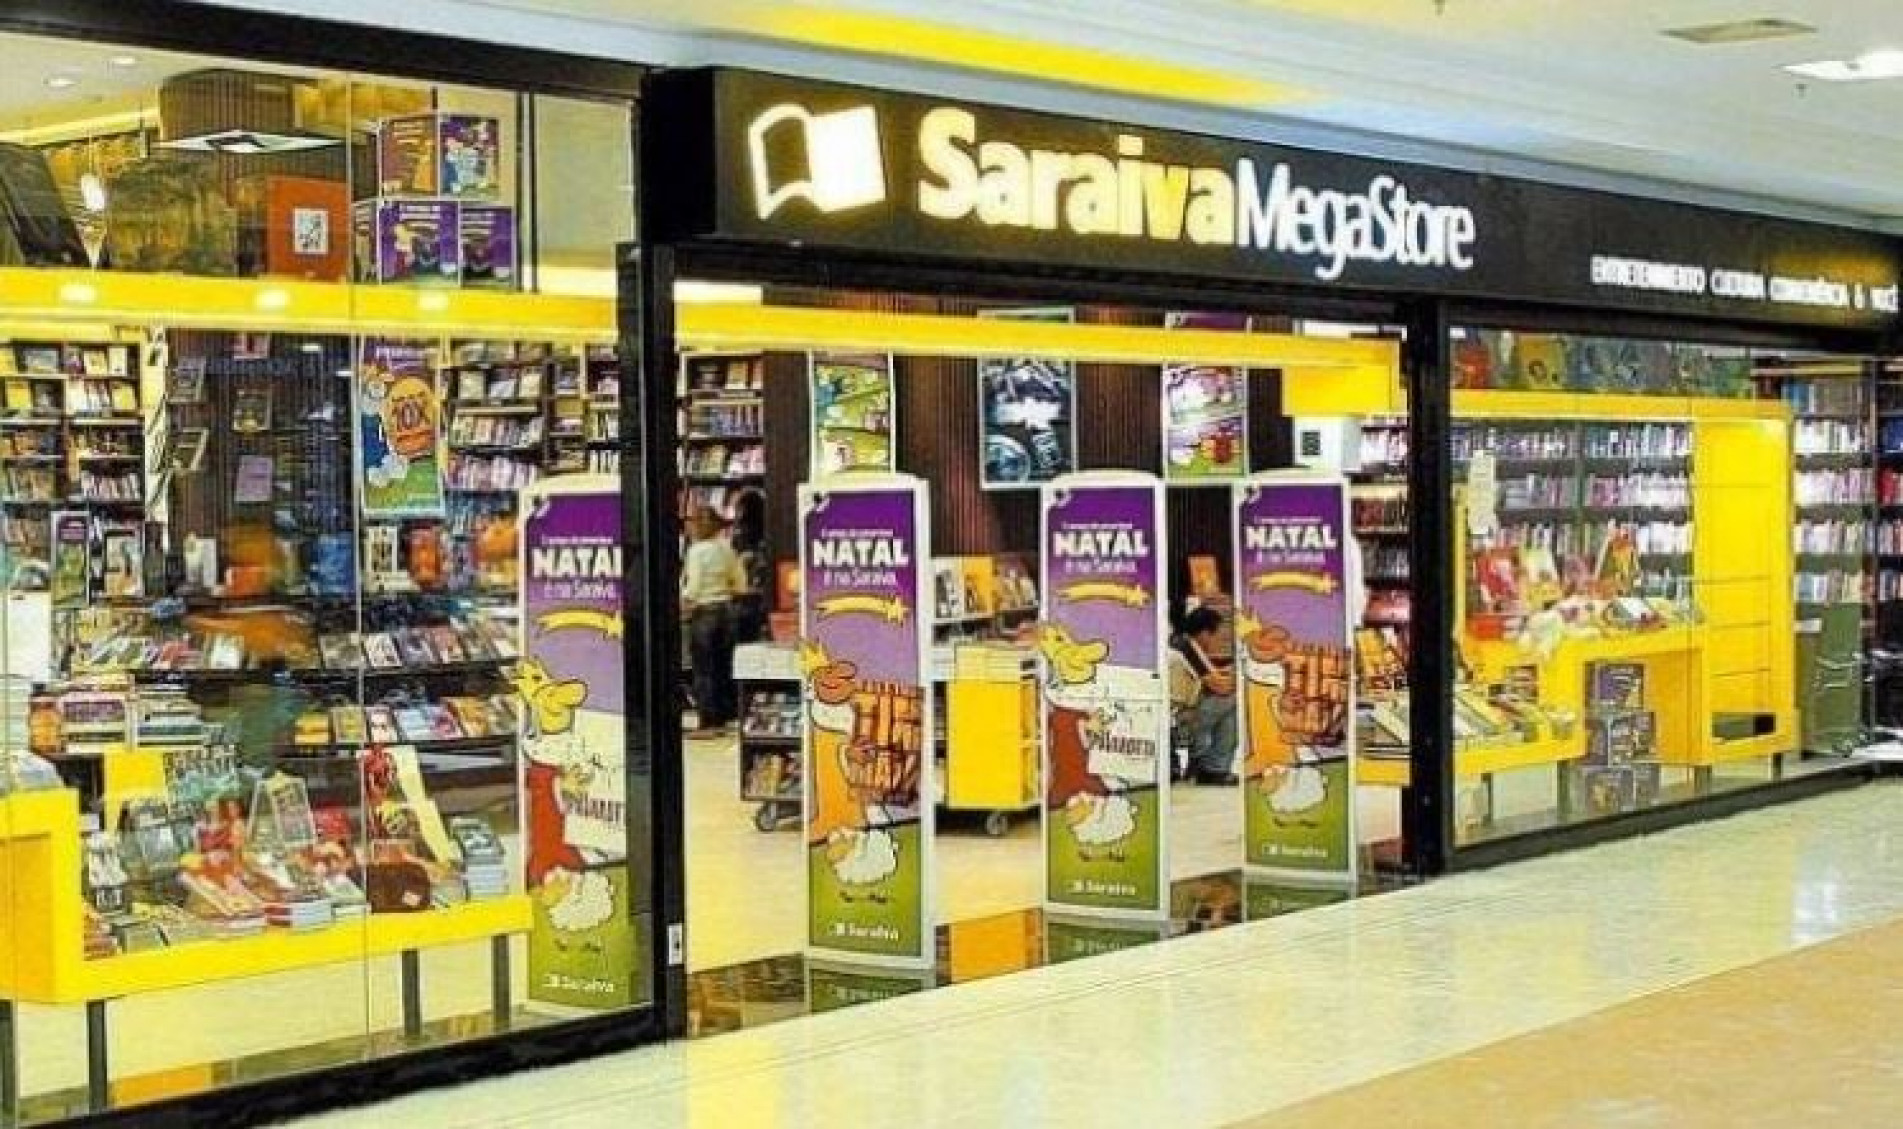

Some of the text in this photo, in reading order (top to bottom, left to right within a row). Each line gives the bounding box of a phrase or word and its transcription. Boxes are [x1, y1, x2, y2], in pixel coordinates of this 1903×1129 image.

[1053, 530, 1149, 557] NATAL
[1245, 524, 1338, 550] NATAL
[813, 538, 909, 567] NATAL
